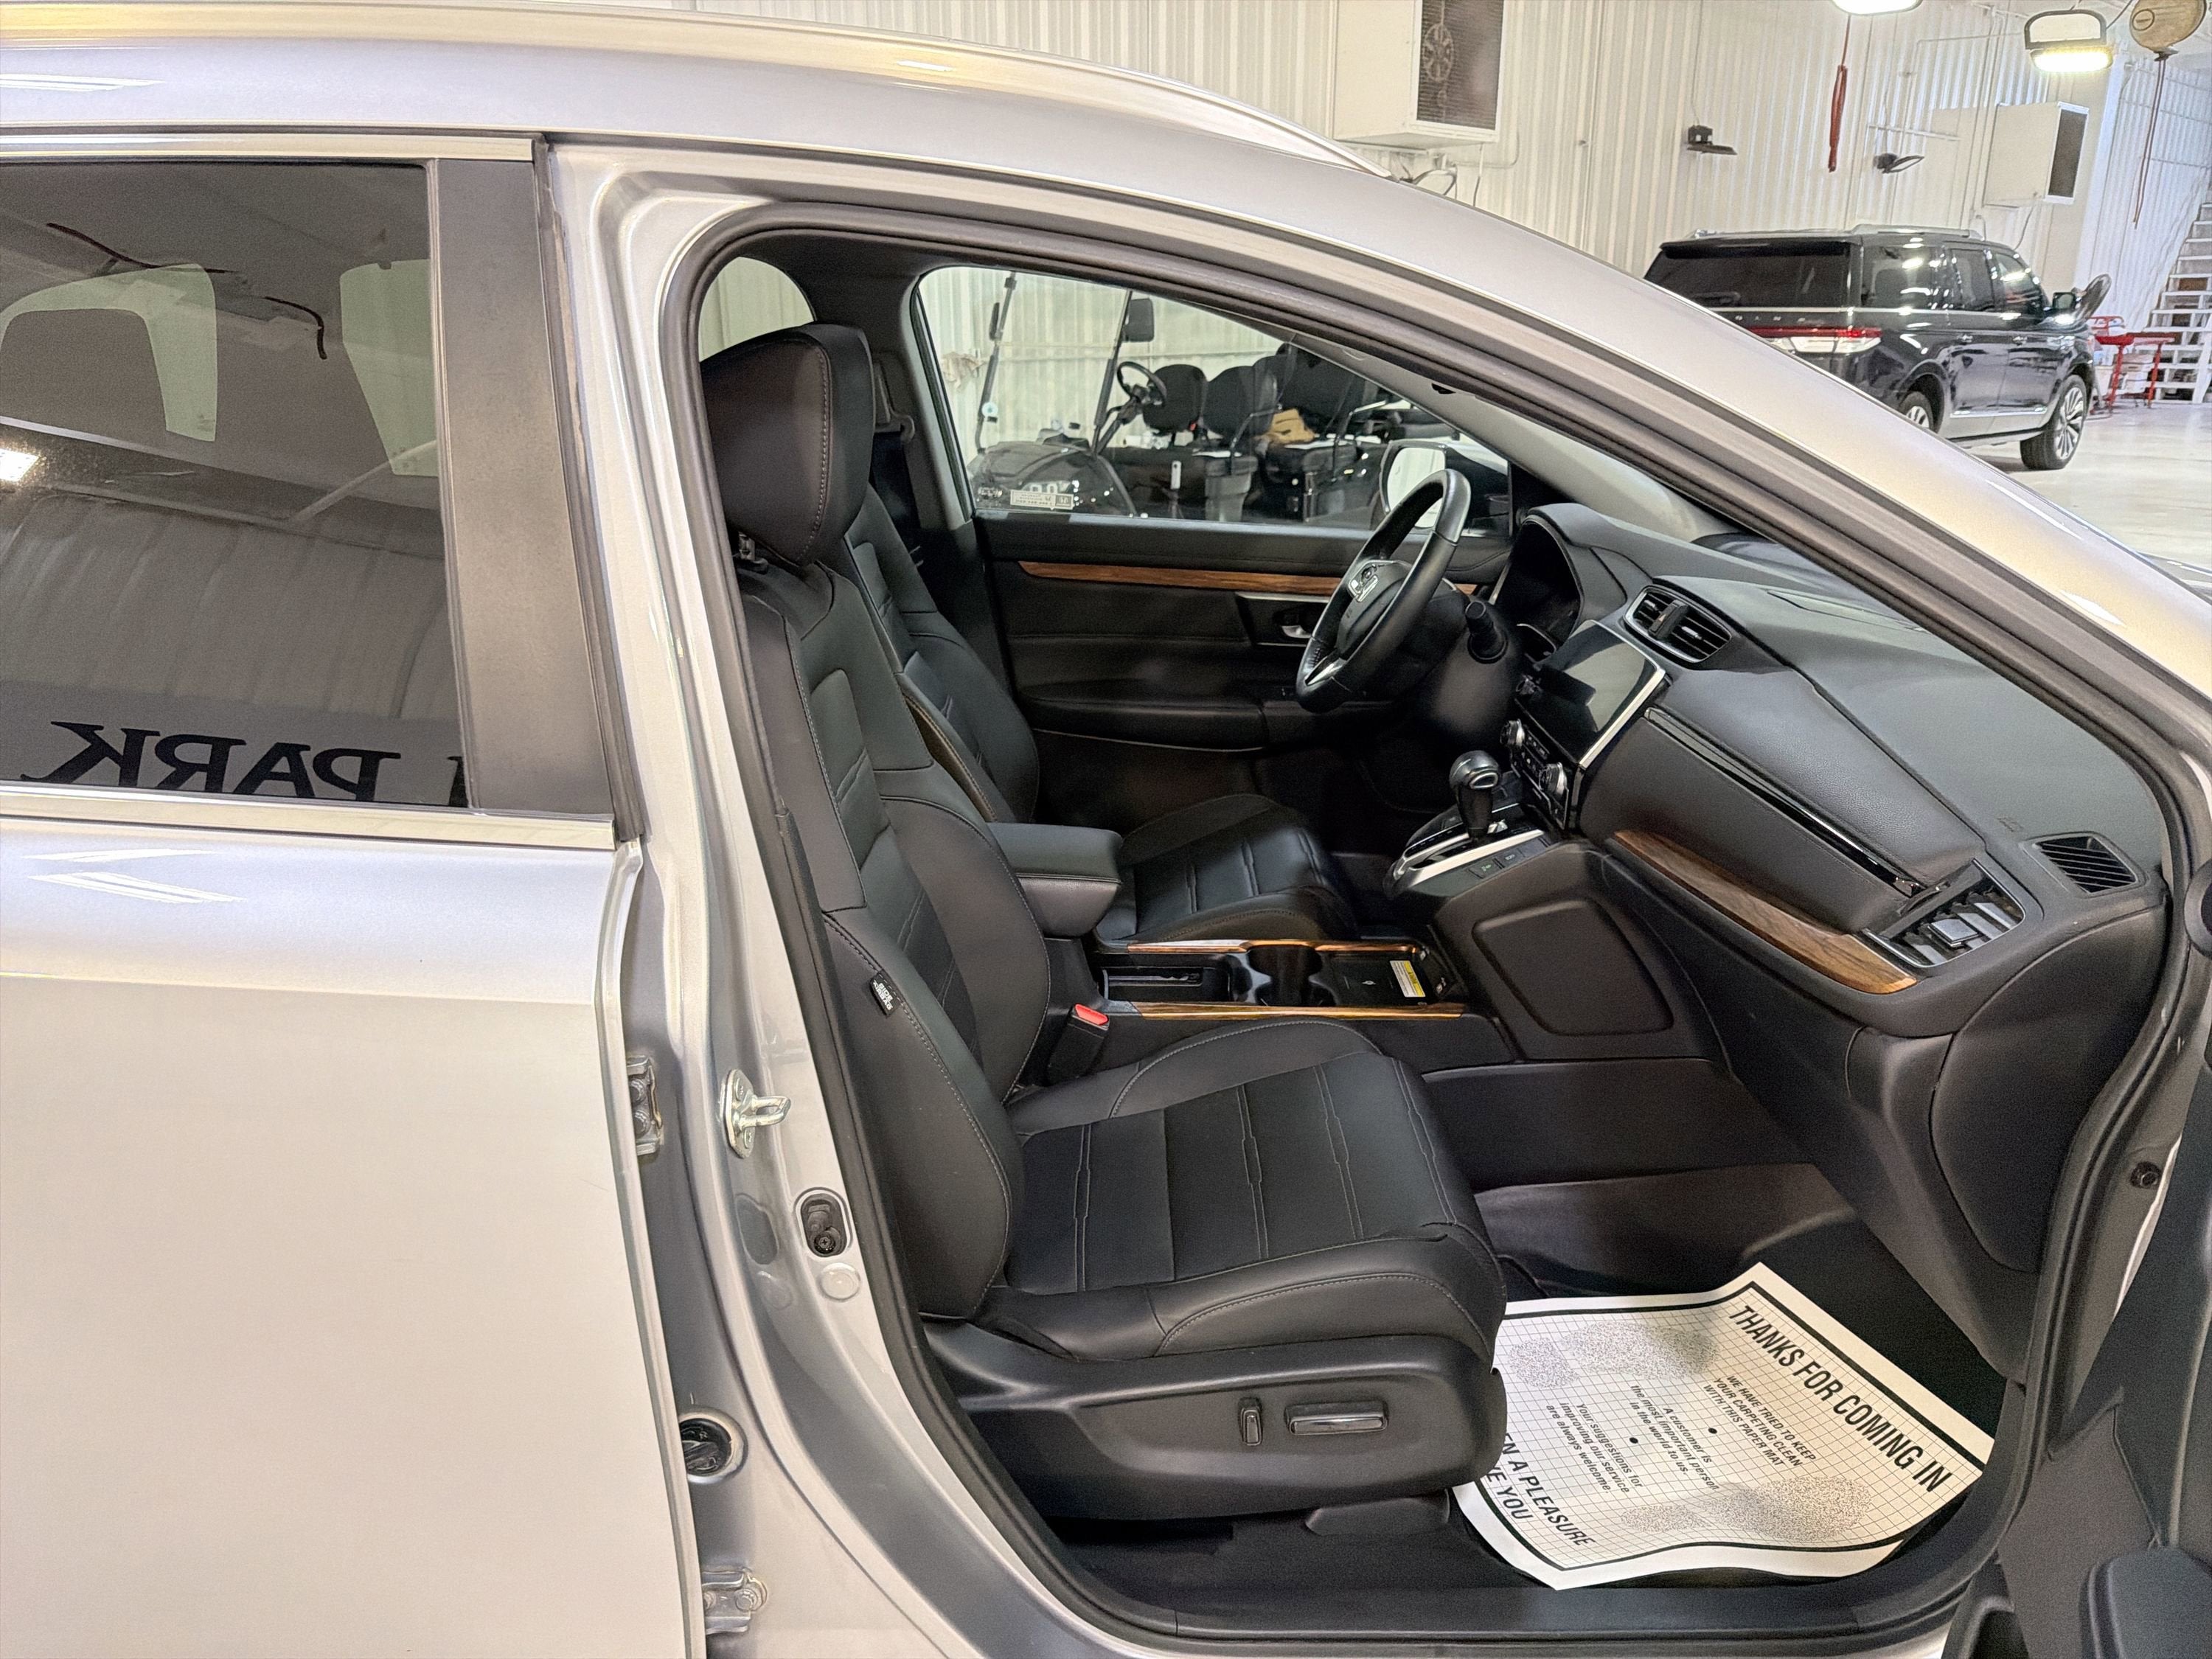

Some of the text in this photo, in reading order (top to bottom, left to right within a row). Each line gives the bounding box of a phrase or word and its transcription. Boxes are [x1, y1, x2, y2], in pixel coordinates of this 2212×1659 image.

[873, 979, 894, 1010] AIRBAG
[878, 982, 893, 1002] SIDE
[1630, 1385, 1719, 1490] the most important person
[1630, 1402, 1688, 1475] in the world to us.
[1670, 1416, 1705, 1453] customer
[1701, 1455, 1712, 1463] is
[1703, 1385, 1785, 1466] WITH THIS PAPER MAT
[1714, 1378, 1803, 1467] YOUR CARPETING CLEAN
[1727, 1376, 1816, 1460] WE HAVE TRIED TO KEEP
[1729, 1305, 1952, 1492] THANKS FOR COMING IN
[1546, 1405, 1611, 1493] are always welcome.
[1559, 1402, 1630, 1493] improving our service
[1576, 1403, 1644, 1487] Your suggestions for
[1497, 1486, 1534, 1520] YOU
[1508, 1461, 1528, 1472] A
[1519, 1475, 1596, 1545] PLEASURE
